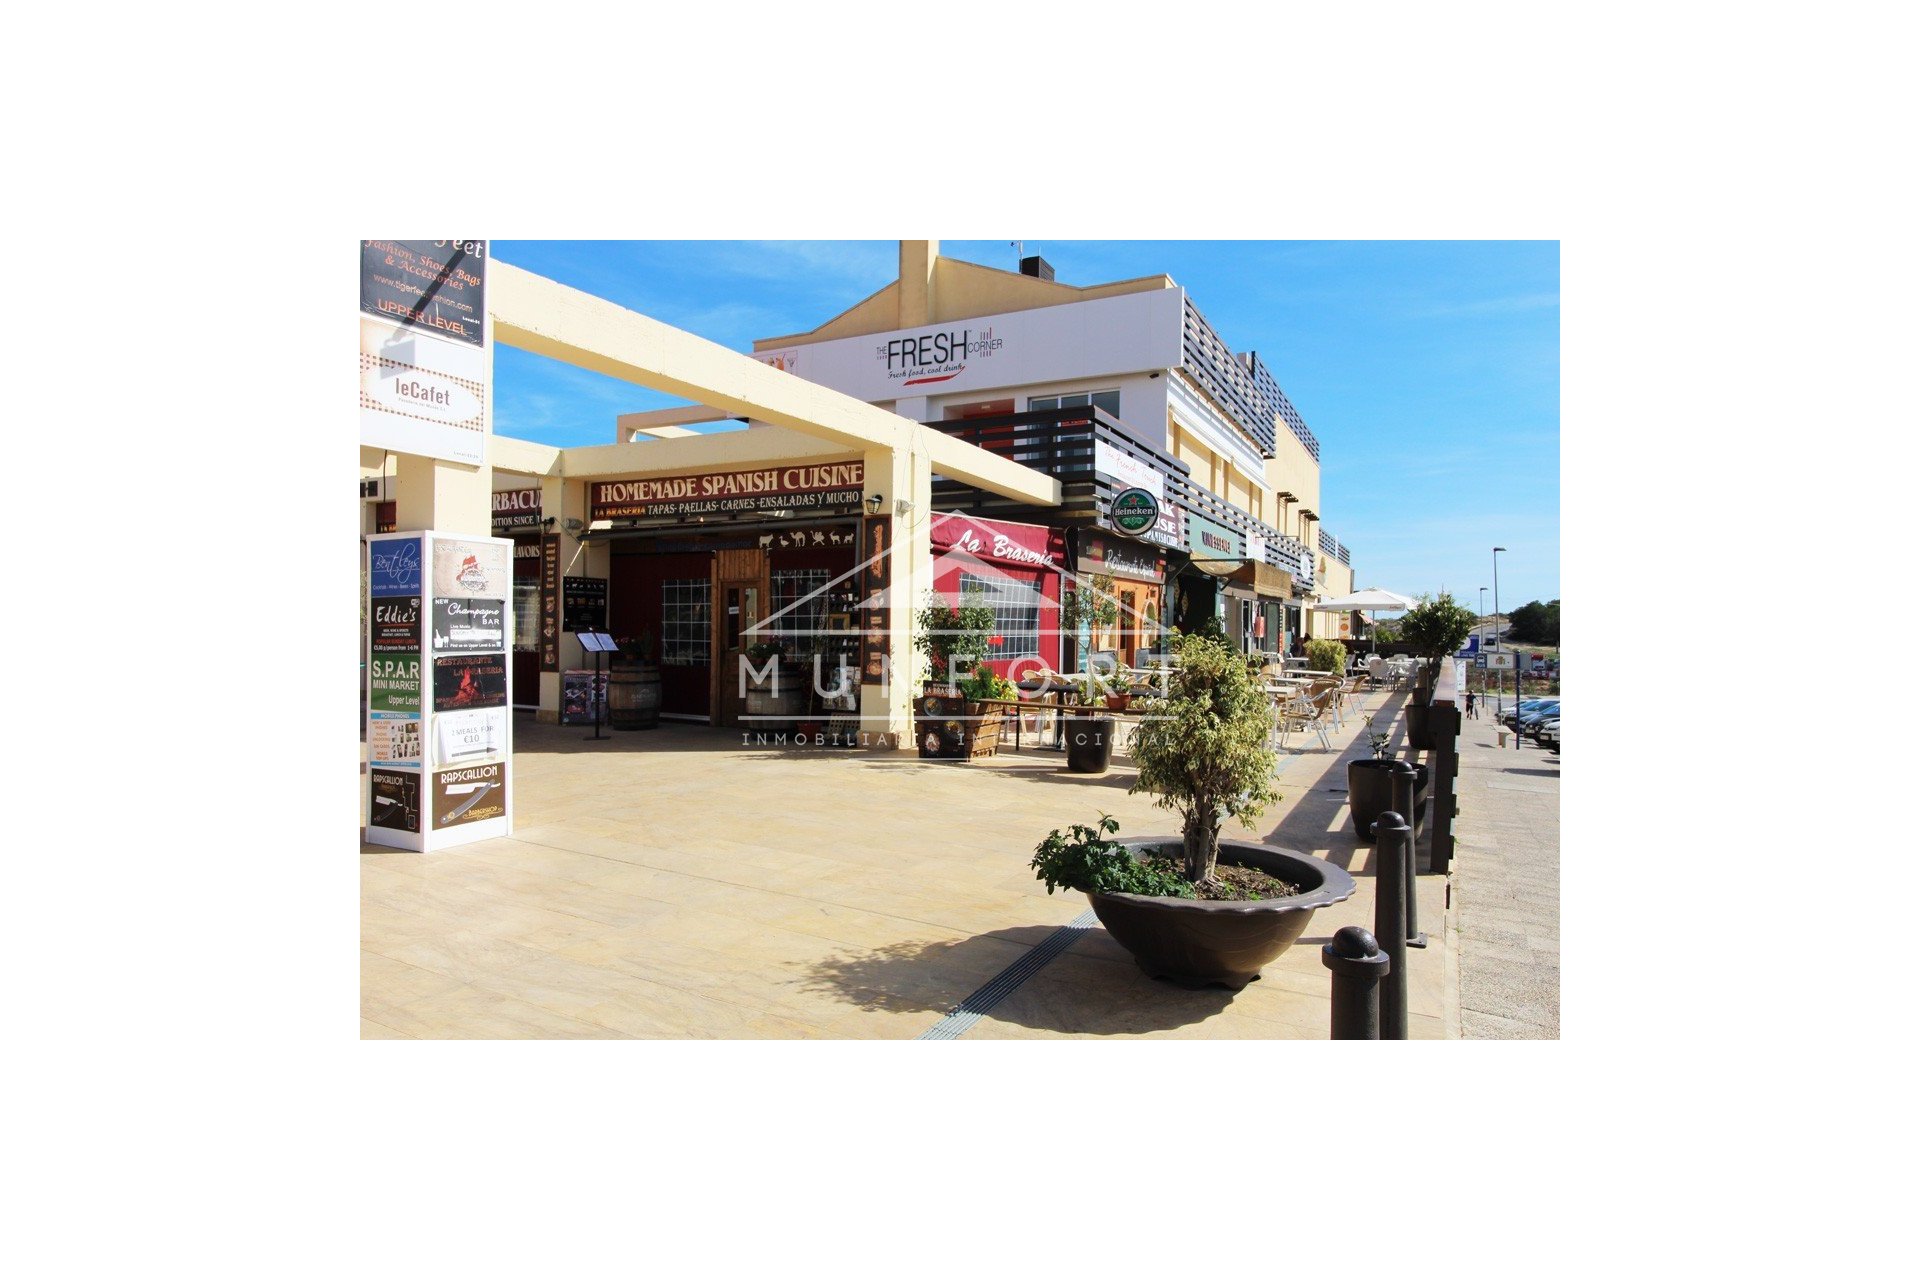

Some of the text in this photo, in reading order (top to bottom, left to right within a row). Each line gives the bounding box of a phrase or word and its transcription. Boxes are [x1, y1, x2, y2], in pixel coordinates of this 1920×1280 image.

[385, 256, 465, 290] & Accessories
[420, 256, 452, 277] Shoes,
[456, 268, 481, 287] Bags
[378, 299, 468, 336] UPPER LEVEL
[876, 331, 1003, 369] THE FRESH CORNER
[888, 370, 906, 379] Fresh
[908, 368, 926, 378] food,
[928, 365, 941, 373] cool
[395, 377, 450, 406] leCafet
[600, 463, 865, 503] HOMEMADE SPANISH CUISINE
[606, 507, 646, 516] BRASERIA
[648, 504, 678, 515] TAPAS-
[721, 498, 755, 510] CARNES
[817, 491, 826, 505] Y
[826, 491, 859, 504] MUCHO
[1114, 507, 1154, 516] Heineken
[514, 516, 534, 525] SINCE
[514, 546, 540, 558] LAVORS
[949, 529, 1054, 565] La Braseria
[373, 543, 420, 584] Bentleys
[376, 605, 416, 624] Eddie's
[447, 602, 500, 619] Champagne
[372, 660, 420, 679] S.P.A.R
[436, 656, 493, 667] RESTAURANTE
[372, 680, 420, 691] MINI MARKET
[923, 686, 962, 695] LA BRASERIA
[388, 695, 420, 706] Upper Level
[457, 726, 478, 735] MEALS
[480, 725, 494, 733] FOR
[463, 734, 480, 744] €10
[373, 774, 404, 786] RAPSCALLION
[441, 765, 498, 784] RAPSCALLION
